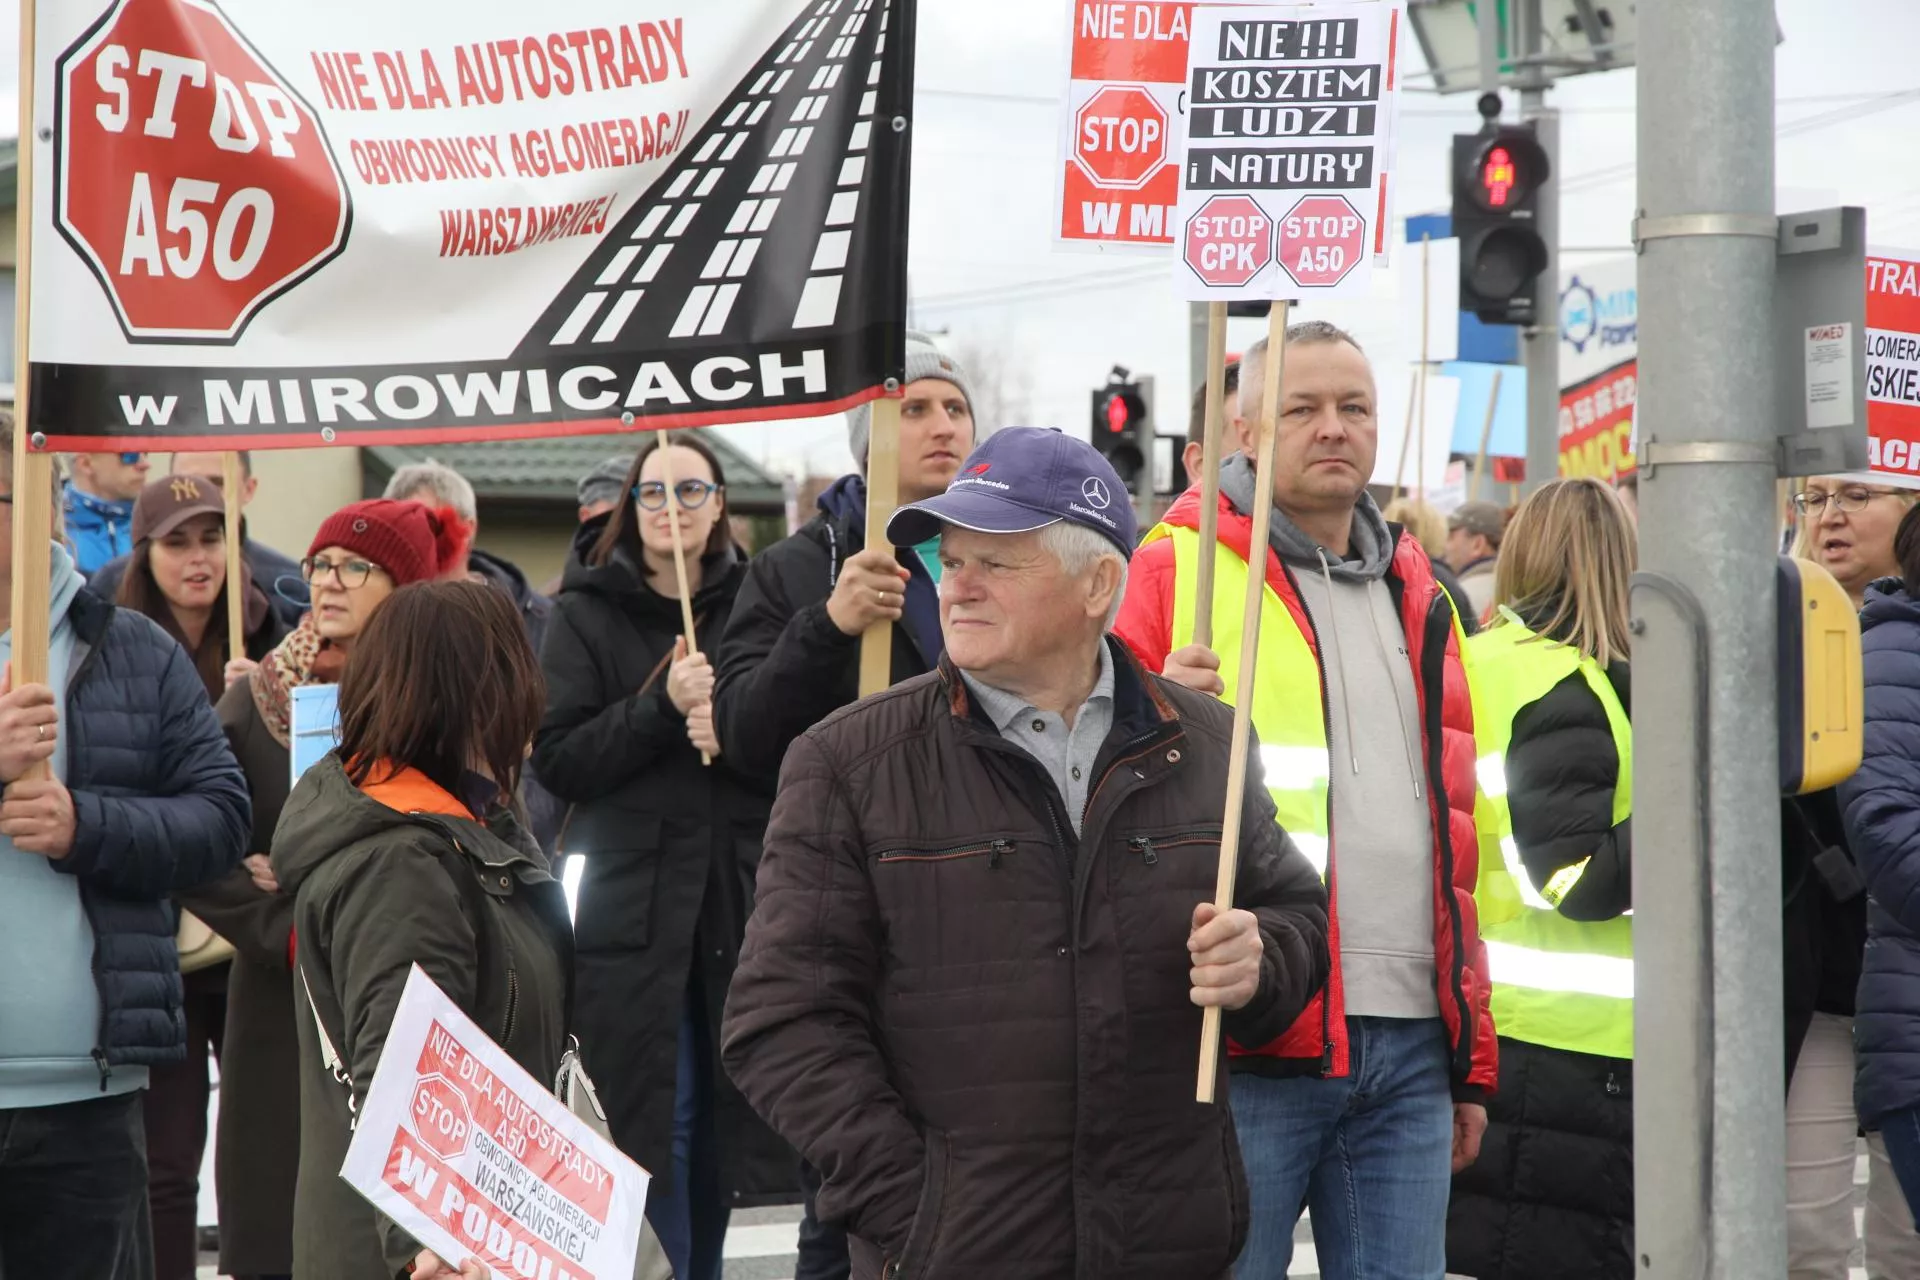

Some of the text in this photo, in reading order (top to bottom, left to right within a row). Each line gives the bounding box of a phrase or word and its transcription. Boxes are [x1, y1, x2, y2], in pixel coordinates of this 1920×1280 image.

[1081, 4, 1189, 41] NIE DLA
[1225, 23, 1288, 59] NIE
[310, 17, 690, 111] NIE DLA AUTOSTRADY
[95, 44, 301, 158] STOP
[1203, 68, 1371, 100] KOSZTEM
[1083, 116, 1160, 154] STOP
[1212, 107, 1359, 137] LUDZI
[349, 109, 691, 186] OBWODNICY AGLOMERACJI
[1190, 153, 1364, 184] i NATURY
[119, 172, 275, 281] A50
[438, 192, 619, 258] WARSZAWSKIEJ
[1081, 202, 1122, 236] W
[1194, 216, 1265, 239] STOP
[1286, 216, 1358, 239] STOP
[1200, 243, 1256, 271] CPK
[1296, 246, 1344, 273] A50
[1867, 259, 1920, 297] TRA
[1866, 334, 1920, 362] LOMER
[203, 349, 827, 425] MIROWICACH
[1865, 364, 1920, 404] SKIE
[415, 1088, 467, 1141] STOP
[429, 1025, 610, 1192] NIE DLA AUTOSTRADY
[494, 1119, 528, 1159] A50
[398, 1145, 438, 1200] W
[474, 1131, 601, 1243] OBWODNICY AGLOMERACJI
[474, 1160, 587, 1263] WARSZAWSKIEJ
